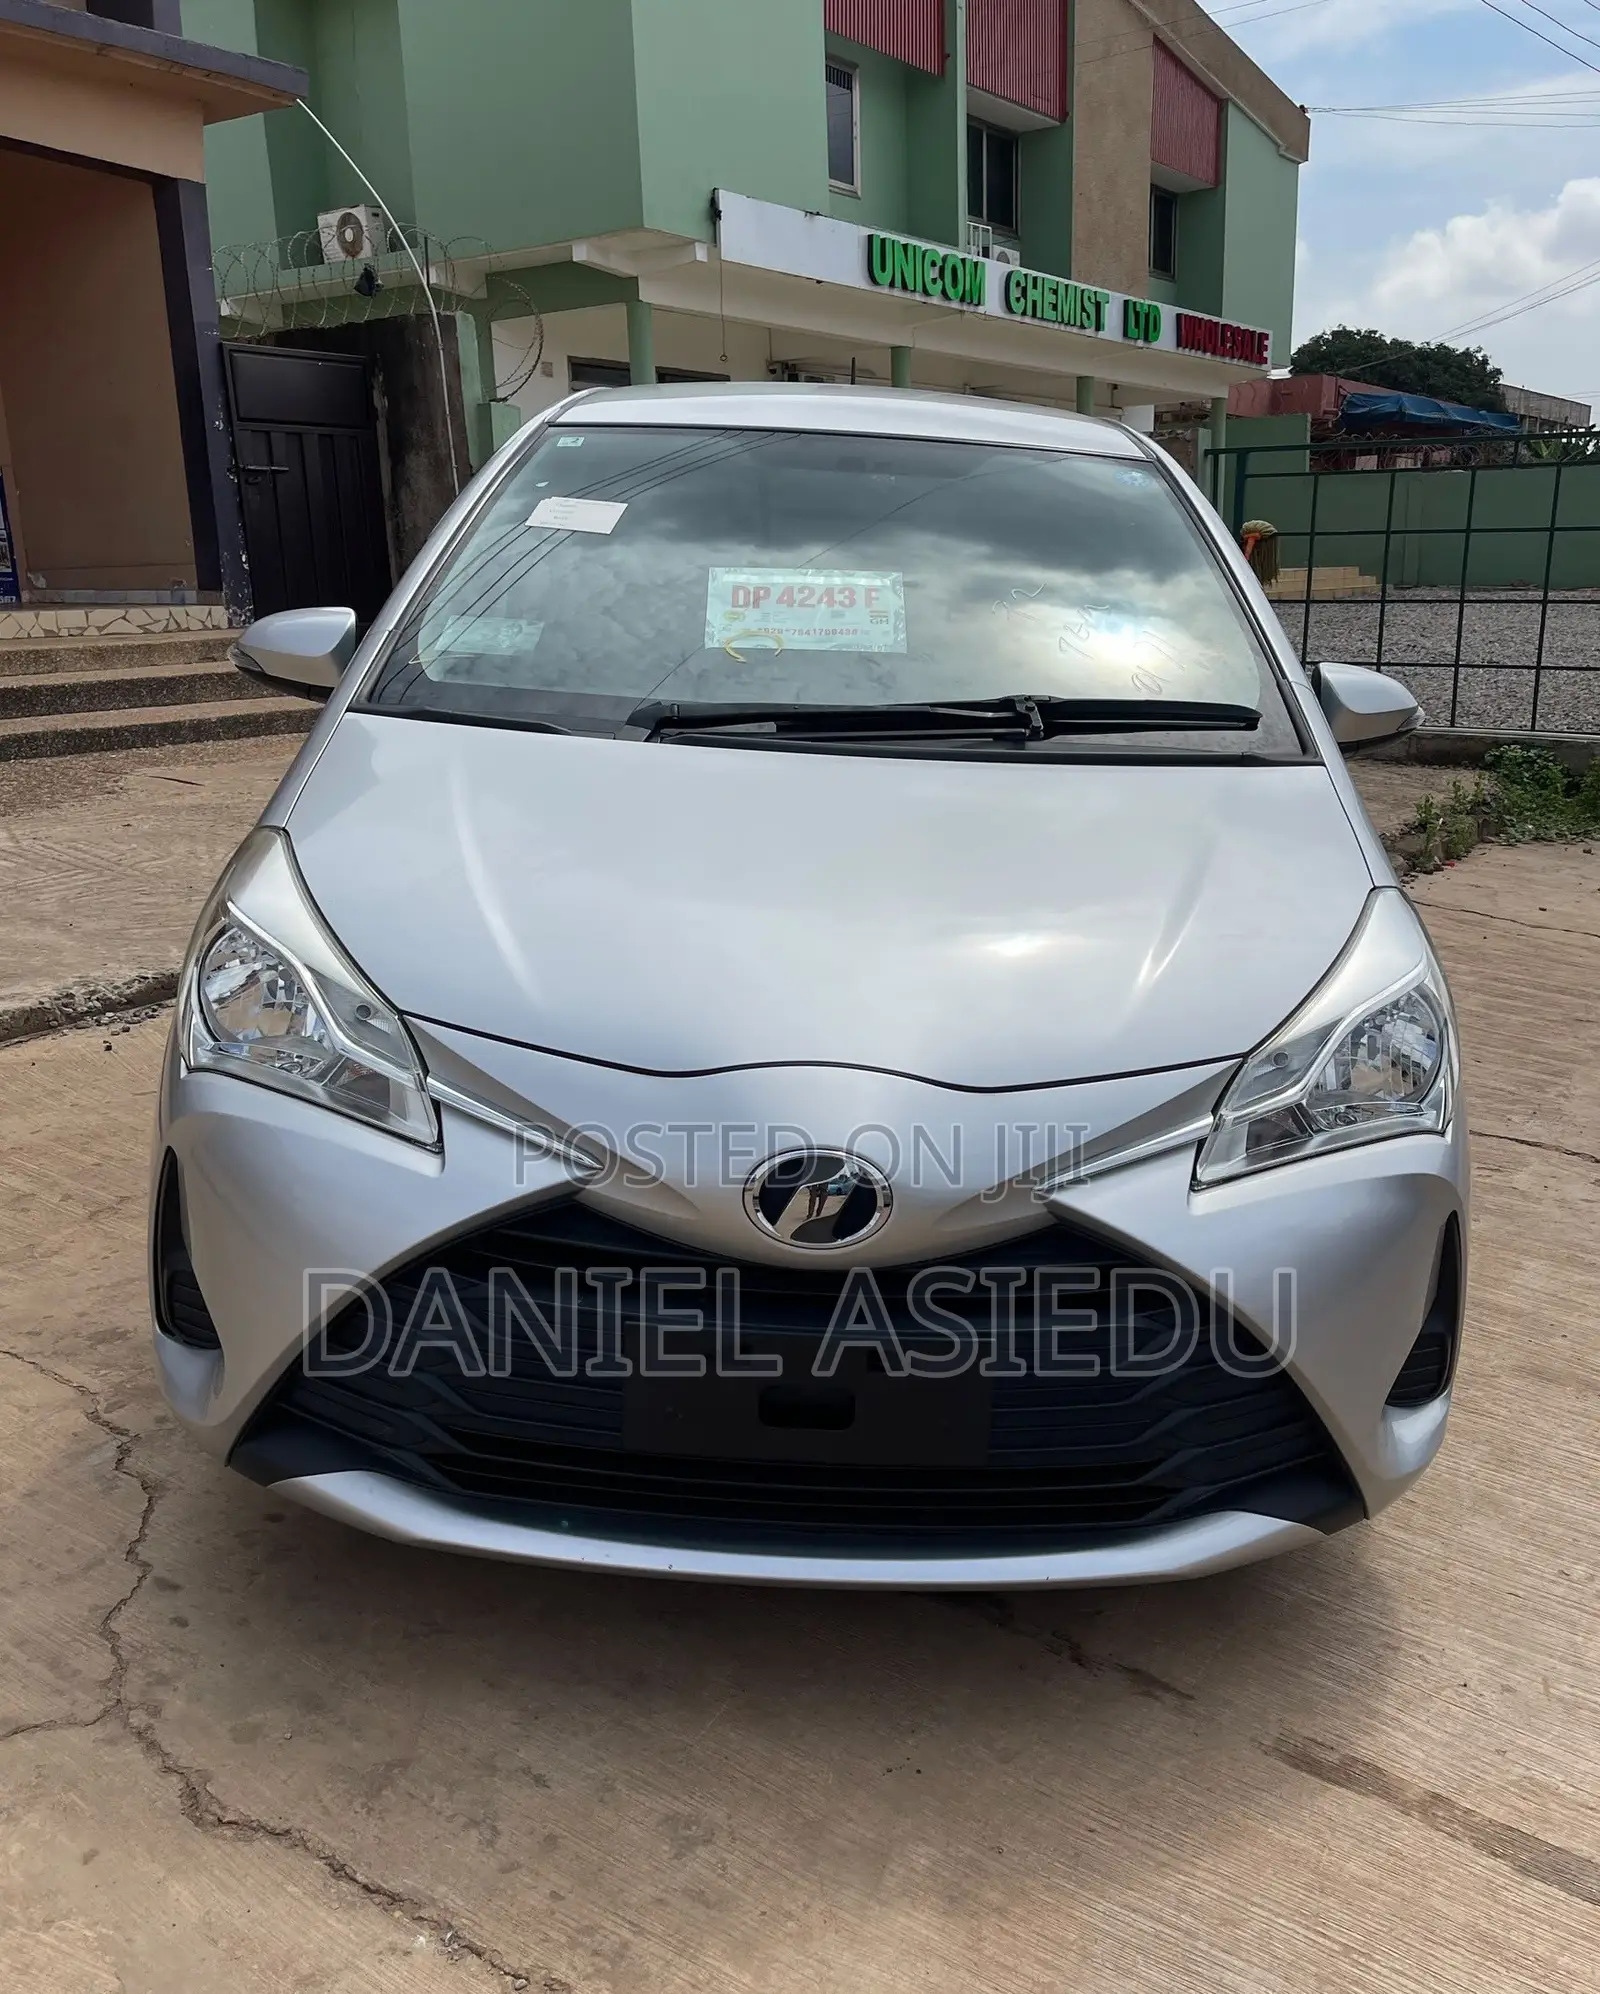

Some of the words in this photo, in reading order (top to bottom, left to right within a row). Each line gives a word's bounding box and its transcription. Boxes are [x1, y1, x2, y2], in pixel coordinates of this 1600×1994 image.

[868, 233, 986, 306] UNICOM
[1005, 269, 1110, 332] CHEMIST
[1123, 299, 1162, 343] LTD
[1175, 312, 1270, 366] WHOLESALE
[731, 584, 772, 609] DP
[775, 586, 857, 609] 4243
